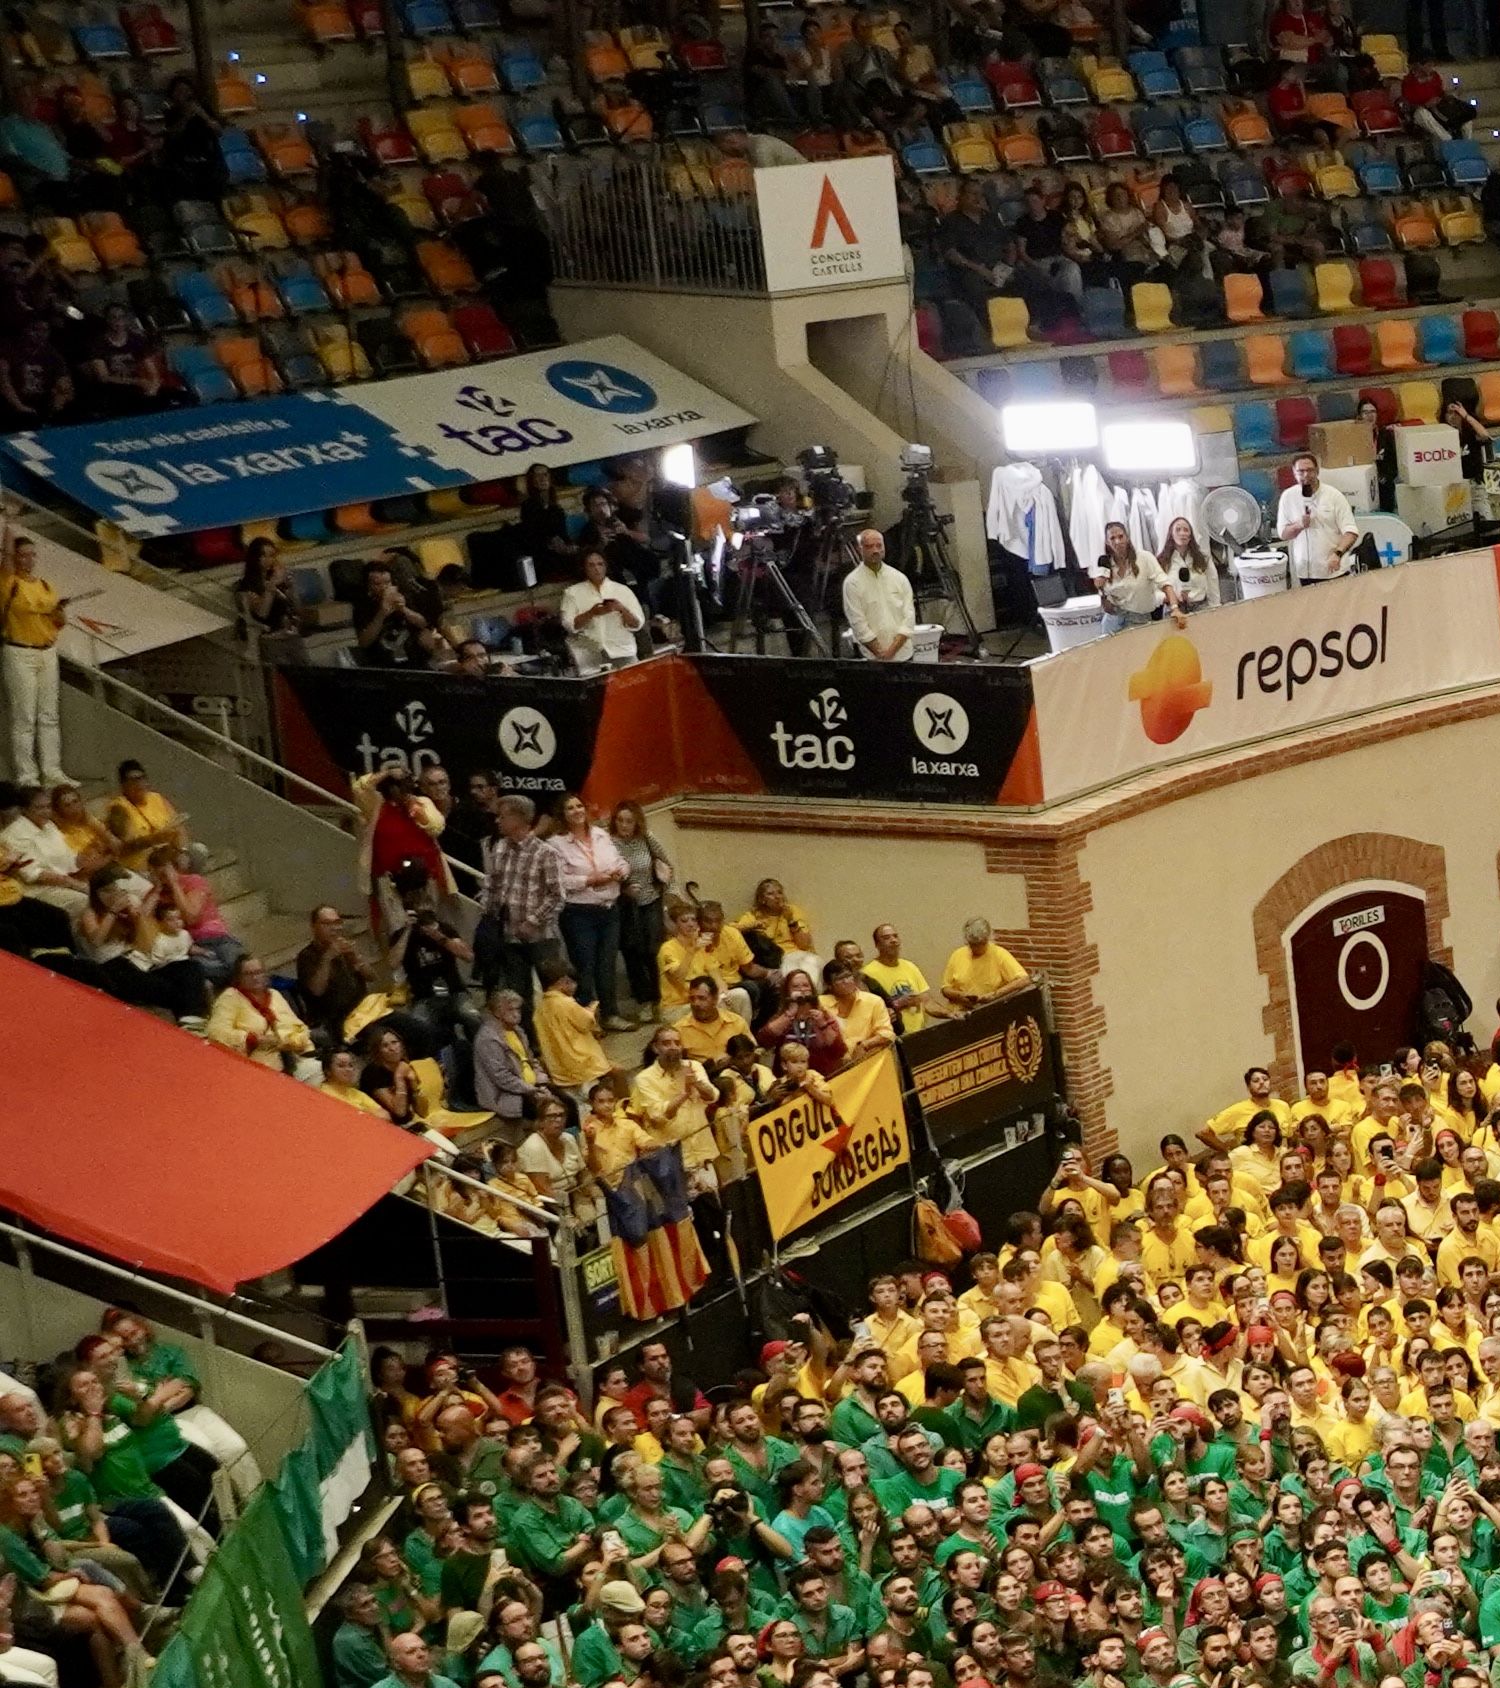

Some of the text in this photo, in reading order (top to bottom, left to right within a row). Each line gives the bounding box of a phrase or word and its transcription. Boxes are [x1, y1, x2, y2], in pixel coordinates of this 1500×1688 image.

[811, 251, 861, 264] CONCURS
[812, 262, 863, 276] CASTELLS
[437, 418, 573, 456] tac
[157, 460, 231, 485] la
[1236, 605, 1389, 701] repsol
[769, 720, 856, 770] tac
[1339, 910, 1380, 932] TORILES
[588, 1255, 613, 1287] SORT
